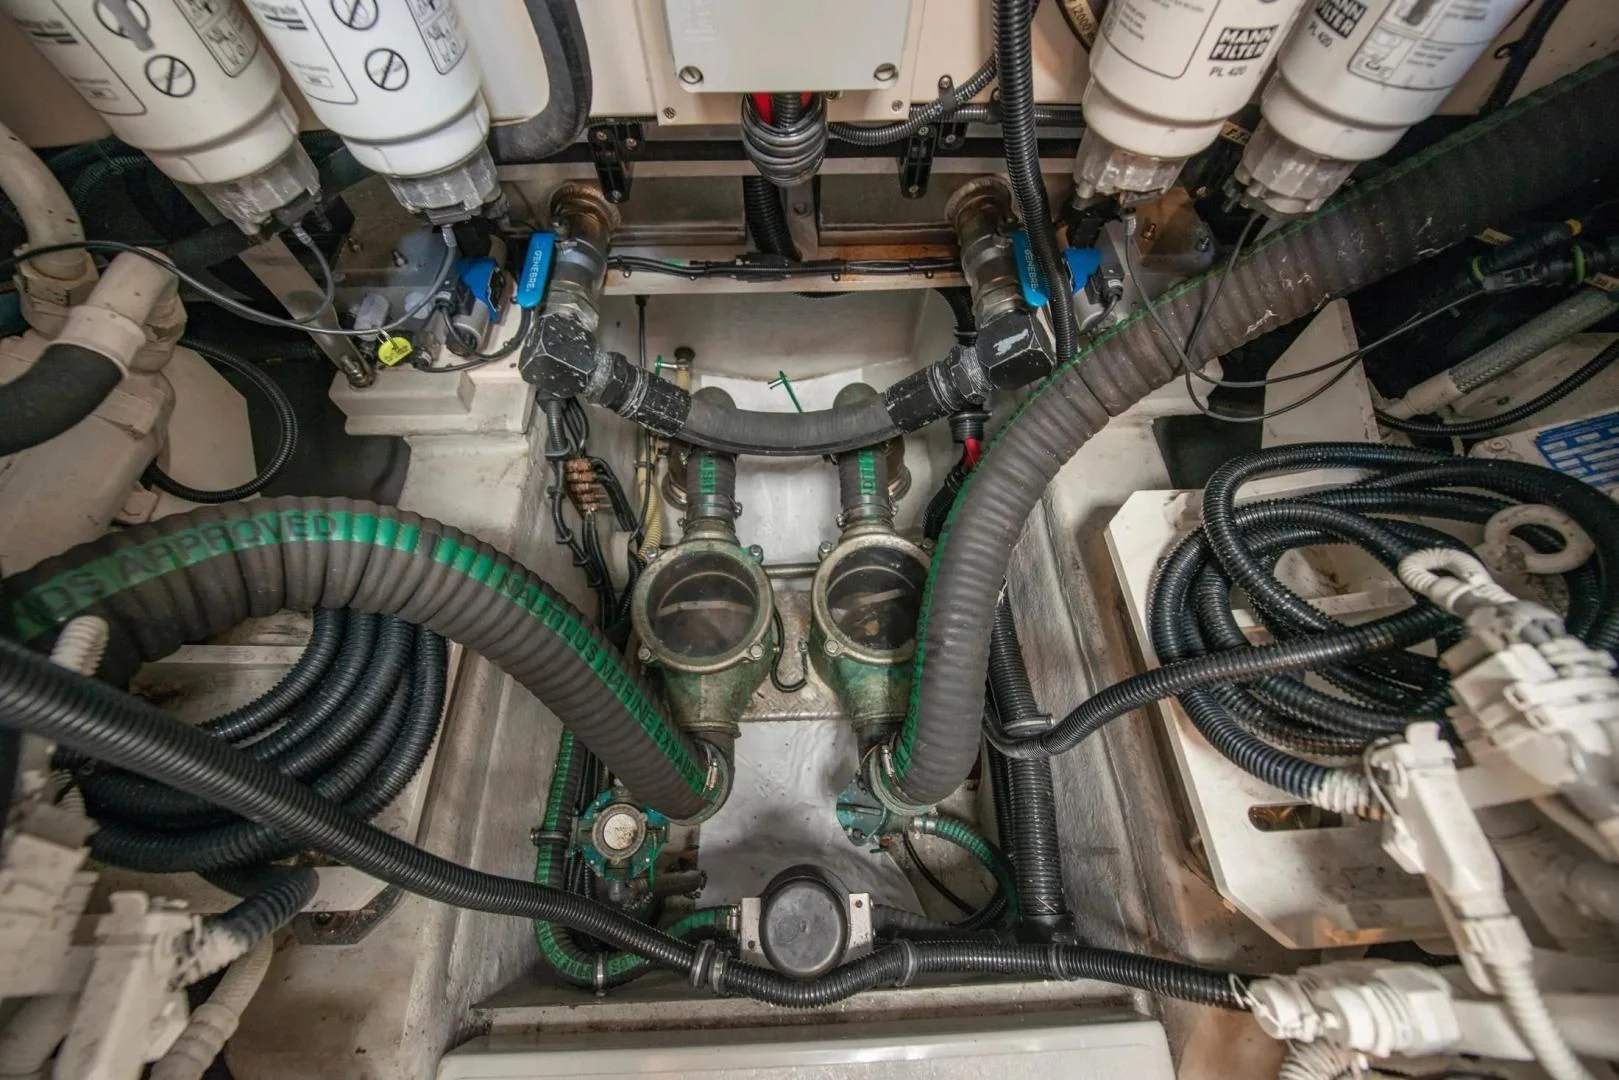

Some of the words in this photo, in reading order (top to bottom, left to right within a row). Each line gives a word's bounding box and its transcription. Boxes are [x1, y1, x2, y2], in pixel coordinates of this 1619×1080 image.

[1219, 28, 1274, 43] MANN
[1209, 66, 1224, 77] PL
[1227, 65, 1248, 76] 420
[119, 511, 336, 581] APPROVED
[499, 571, 599, 664] NAUTILUS
[600, 659, 657, 727] MARINE
